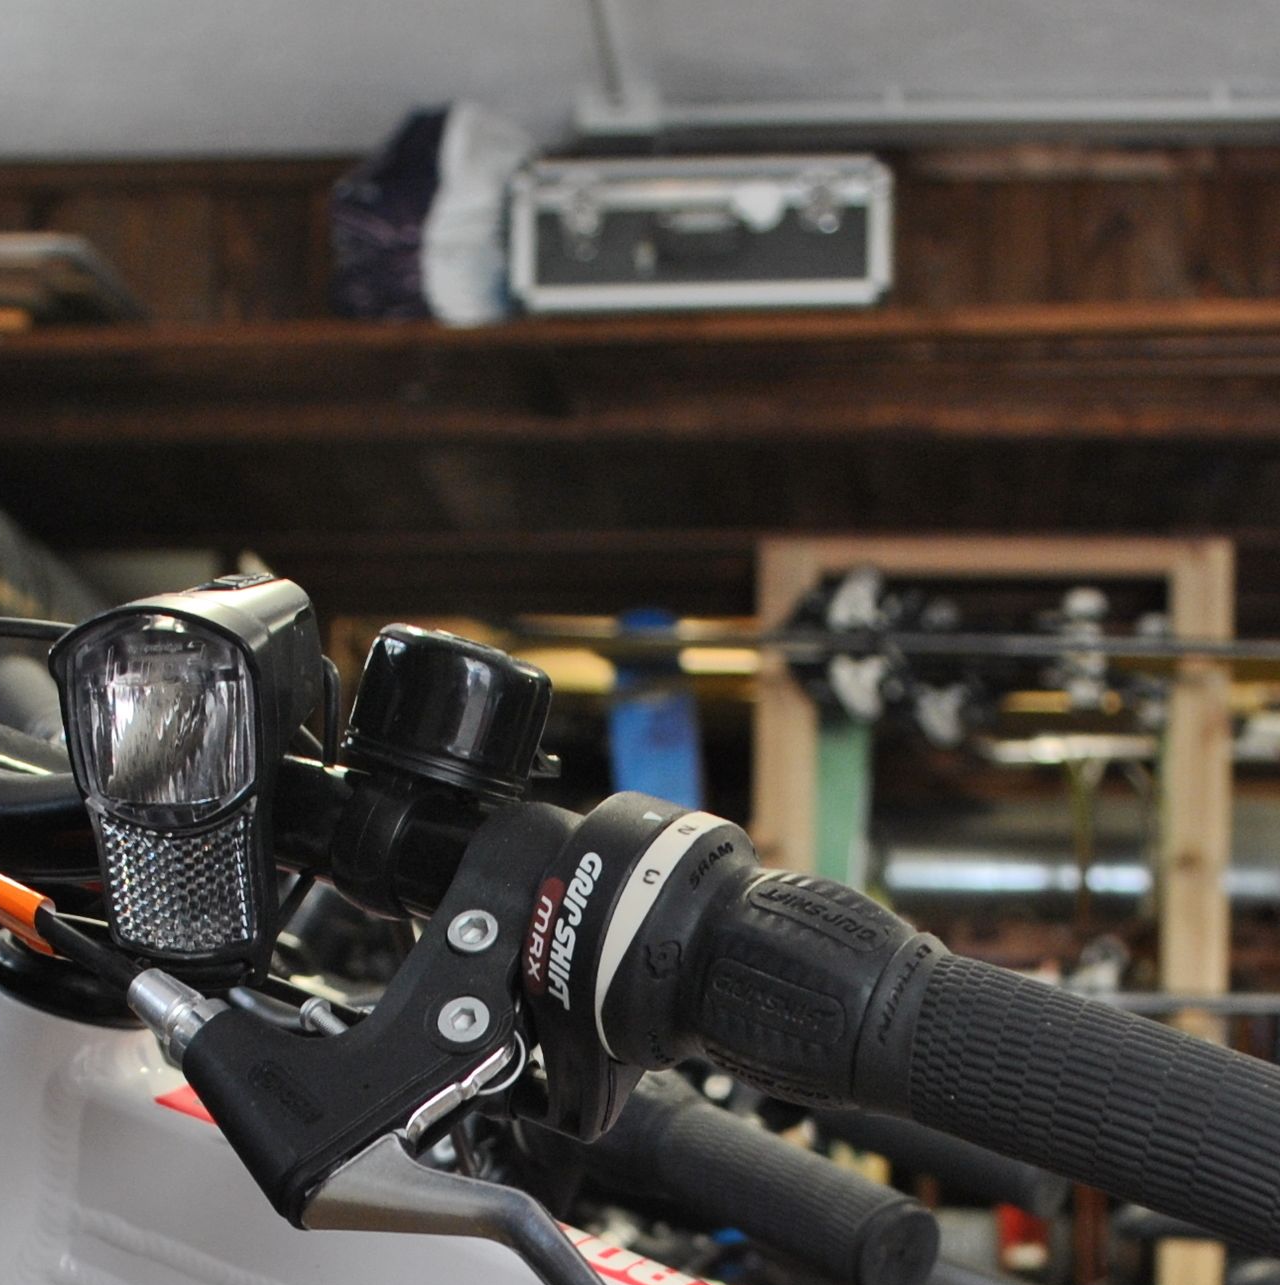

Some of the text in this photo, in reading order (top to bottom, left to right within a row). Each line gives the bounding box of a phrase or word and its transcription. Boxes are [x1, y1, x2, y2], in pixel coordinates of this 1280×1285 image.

[688, 841, 734, 890] SRAM
[527, 895, 553, 982] MRX
[548, 851, 603, 1011] GRIPSHIFT
